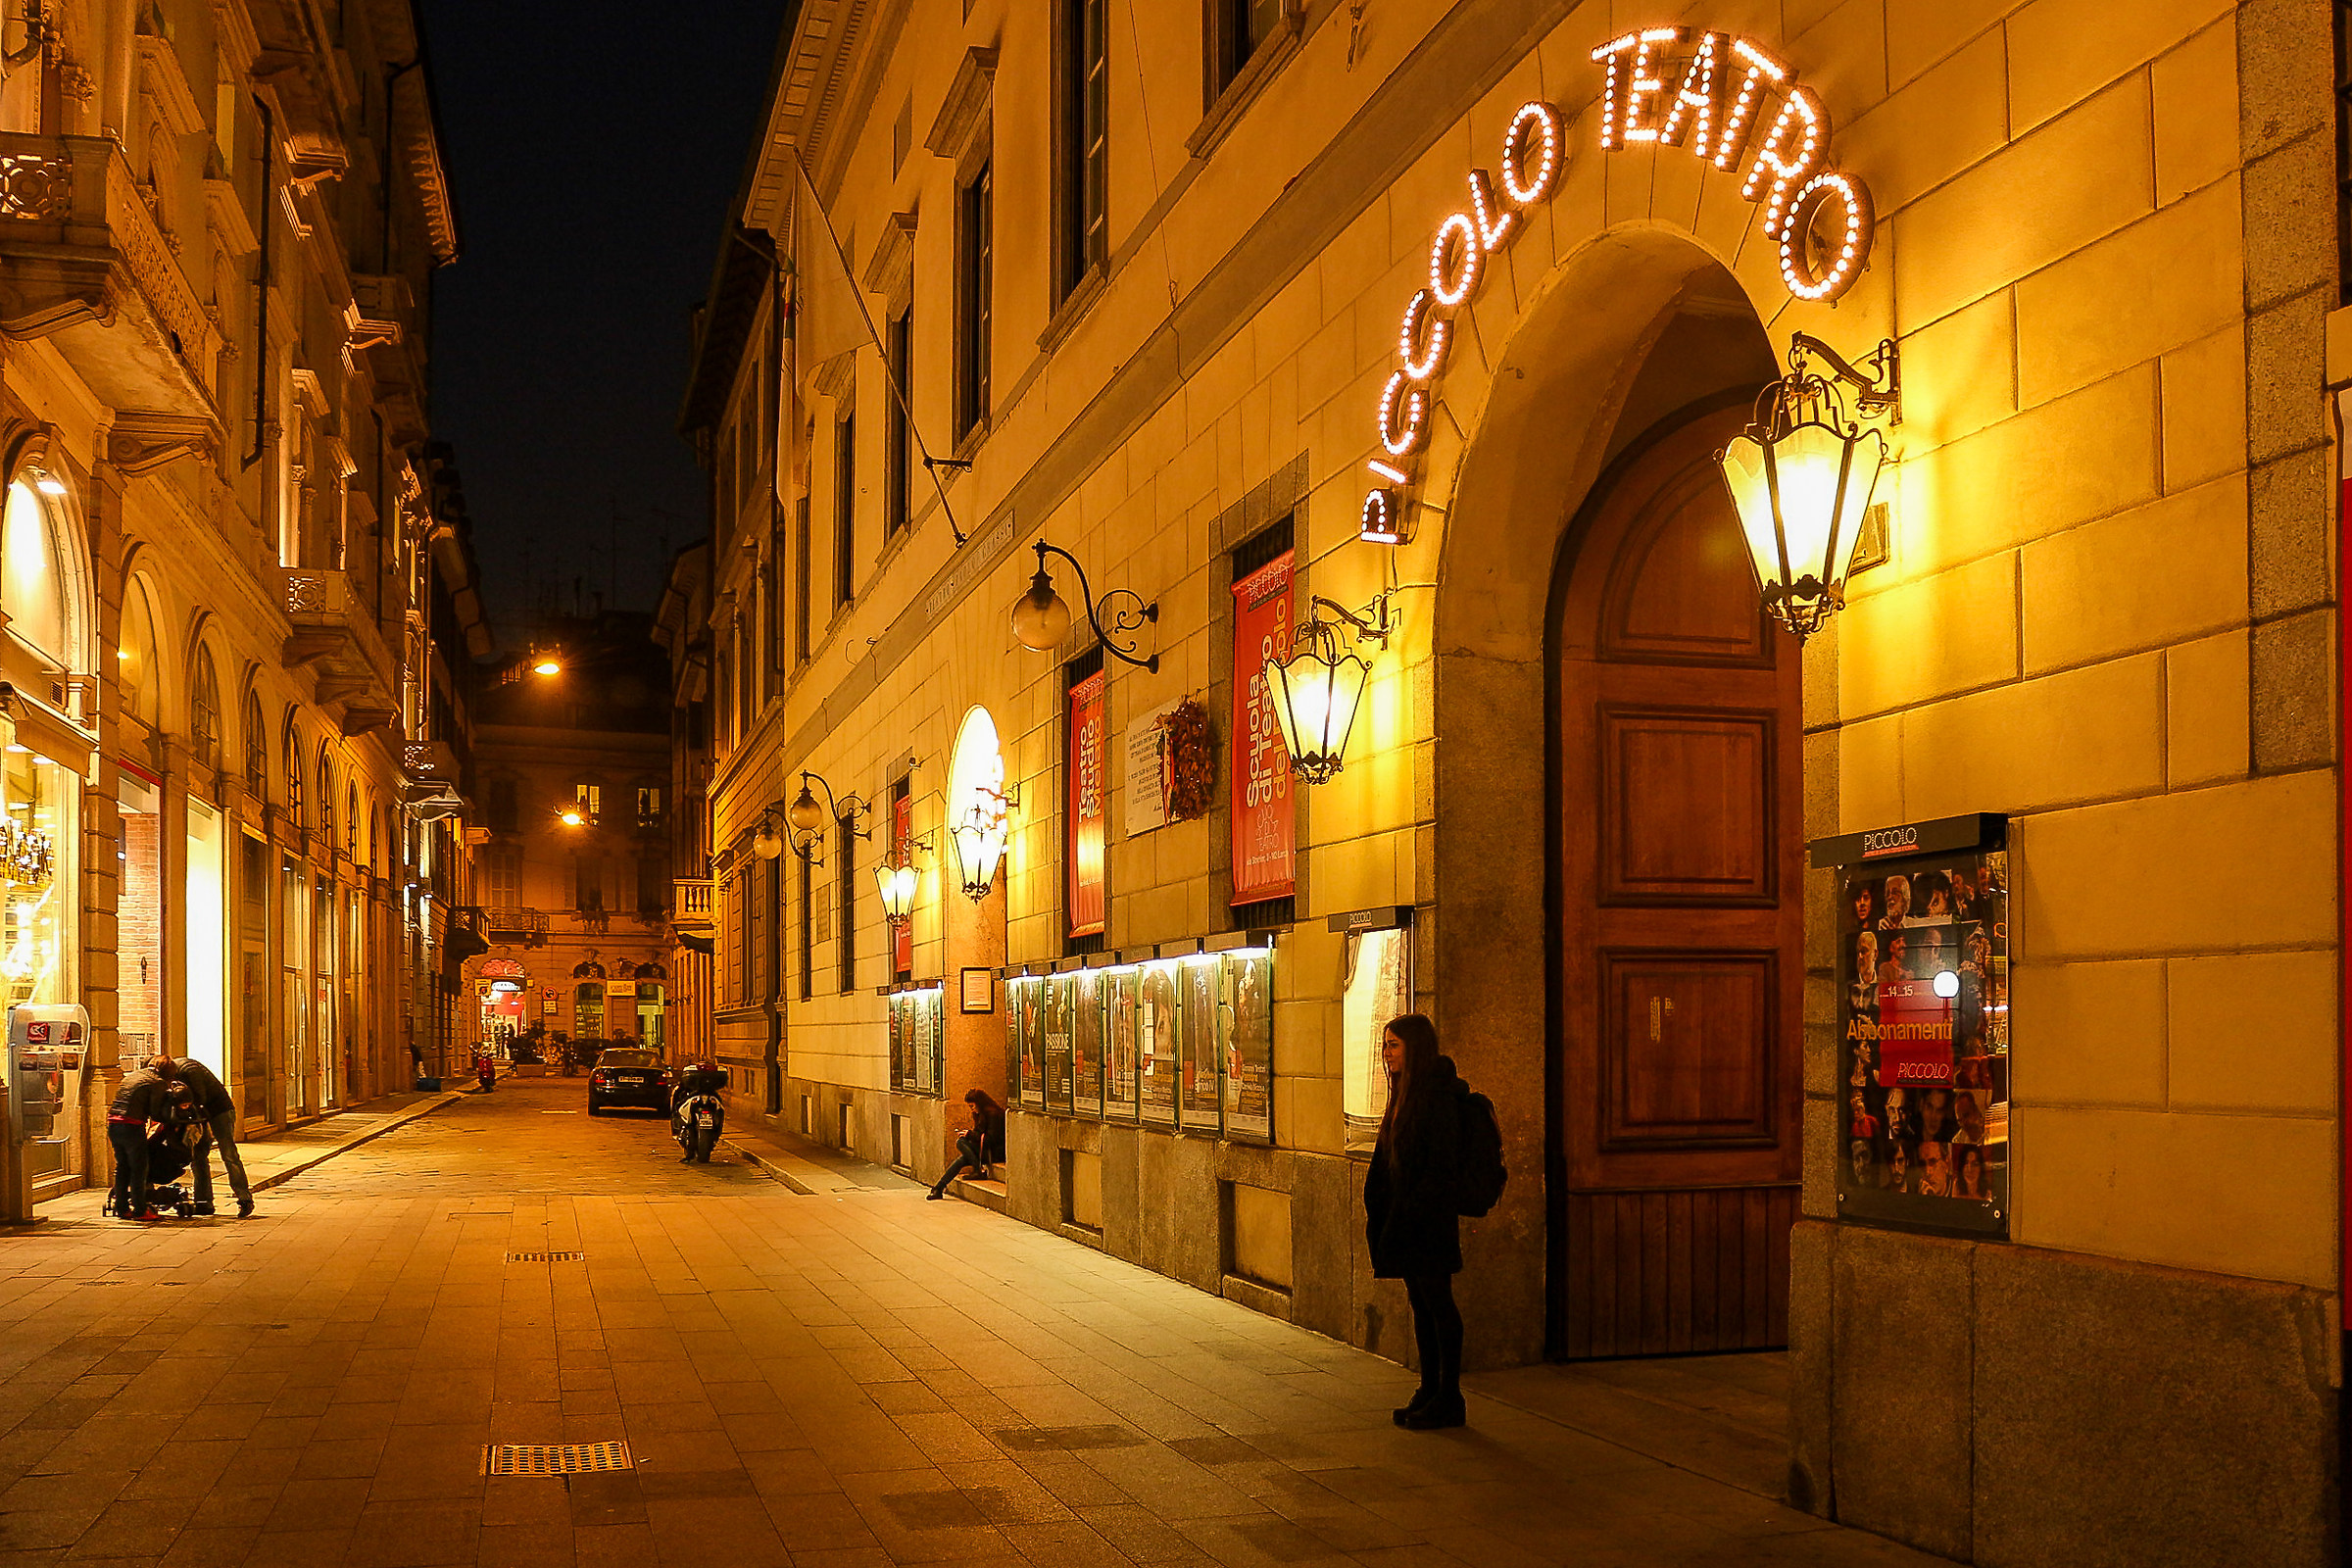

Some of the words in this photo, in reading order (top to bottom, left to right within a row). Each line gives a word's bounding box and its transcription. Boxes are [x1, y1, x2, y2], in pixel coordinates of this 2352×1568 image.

[1360, 101, 1565, 545] PICCOLO
[1591, 26, 1875, 303] TEATRO
[1246, 673, 1259, 808] Scuola
[1086, 719, 1095, 818] Studio
[1259, 767, 1272, 803] di
[1273, 743, 1286, 800] del
[1864, 827, 1917, 852] PICCOLO
[1846, 1018, 1954, 1040] Abbonamenti
[1897, 1062, 1950, 1079] PICCOLO
